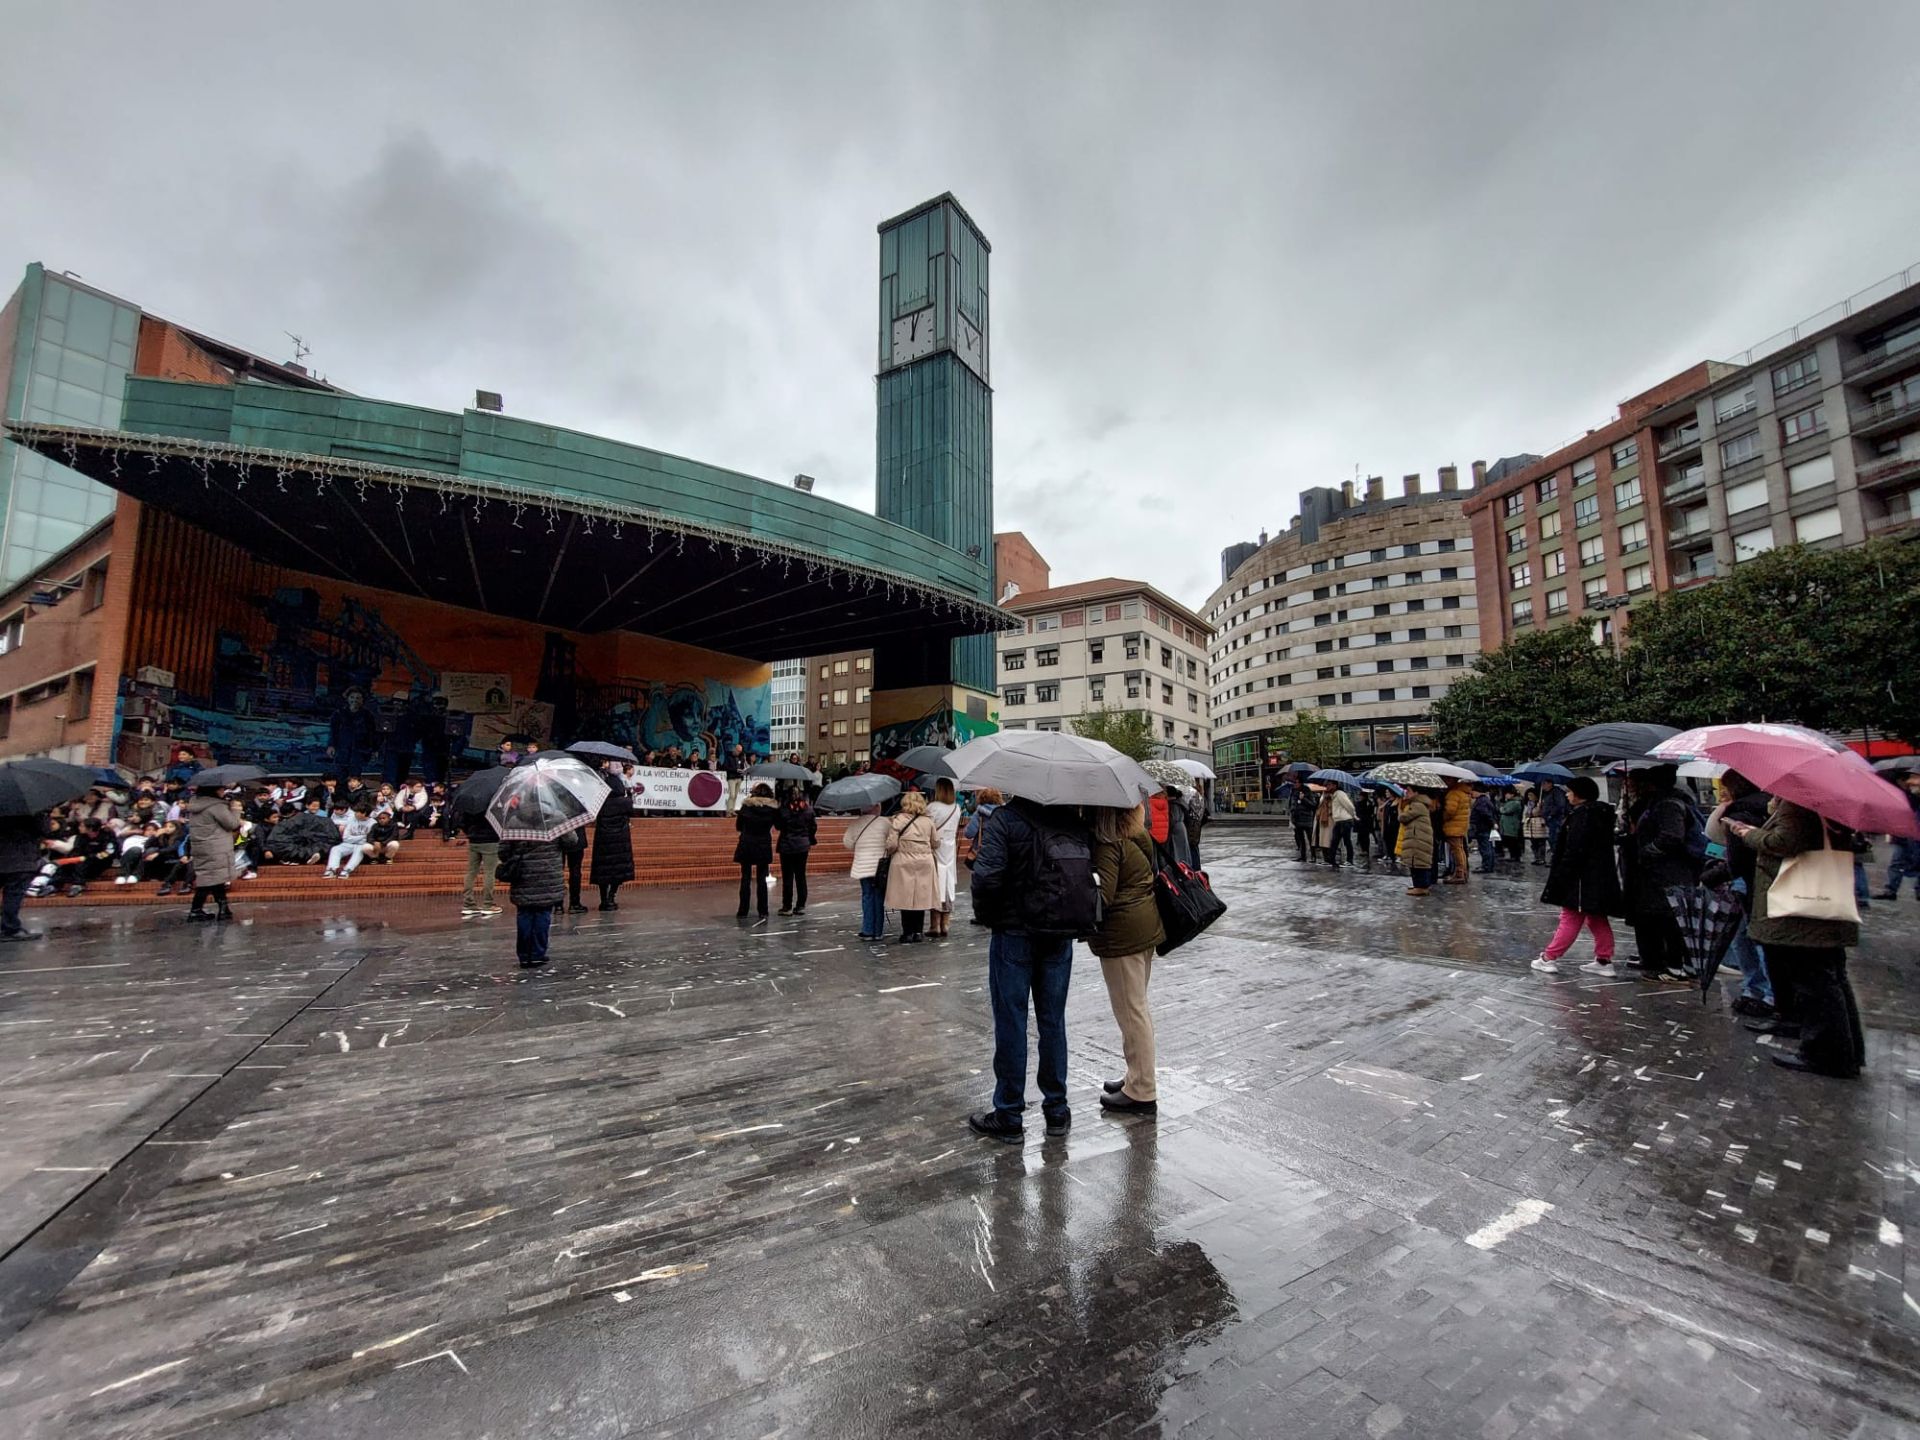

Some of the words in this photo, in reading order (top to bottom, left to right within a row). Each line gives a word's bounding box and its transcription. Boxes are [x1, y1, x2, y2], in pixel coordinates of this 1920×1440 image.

[643, 769, 652, 777] LA
[654, 770, 690, 778] VIOLENCIA
[654, 784, 683, 792] CONTRA
[643, 798, 677, 807] MUJERES
